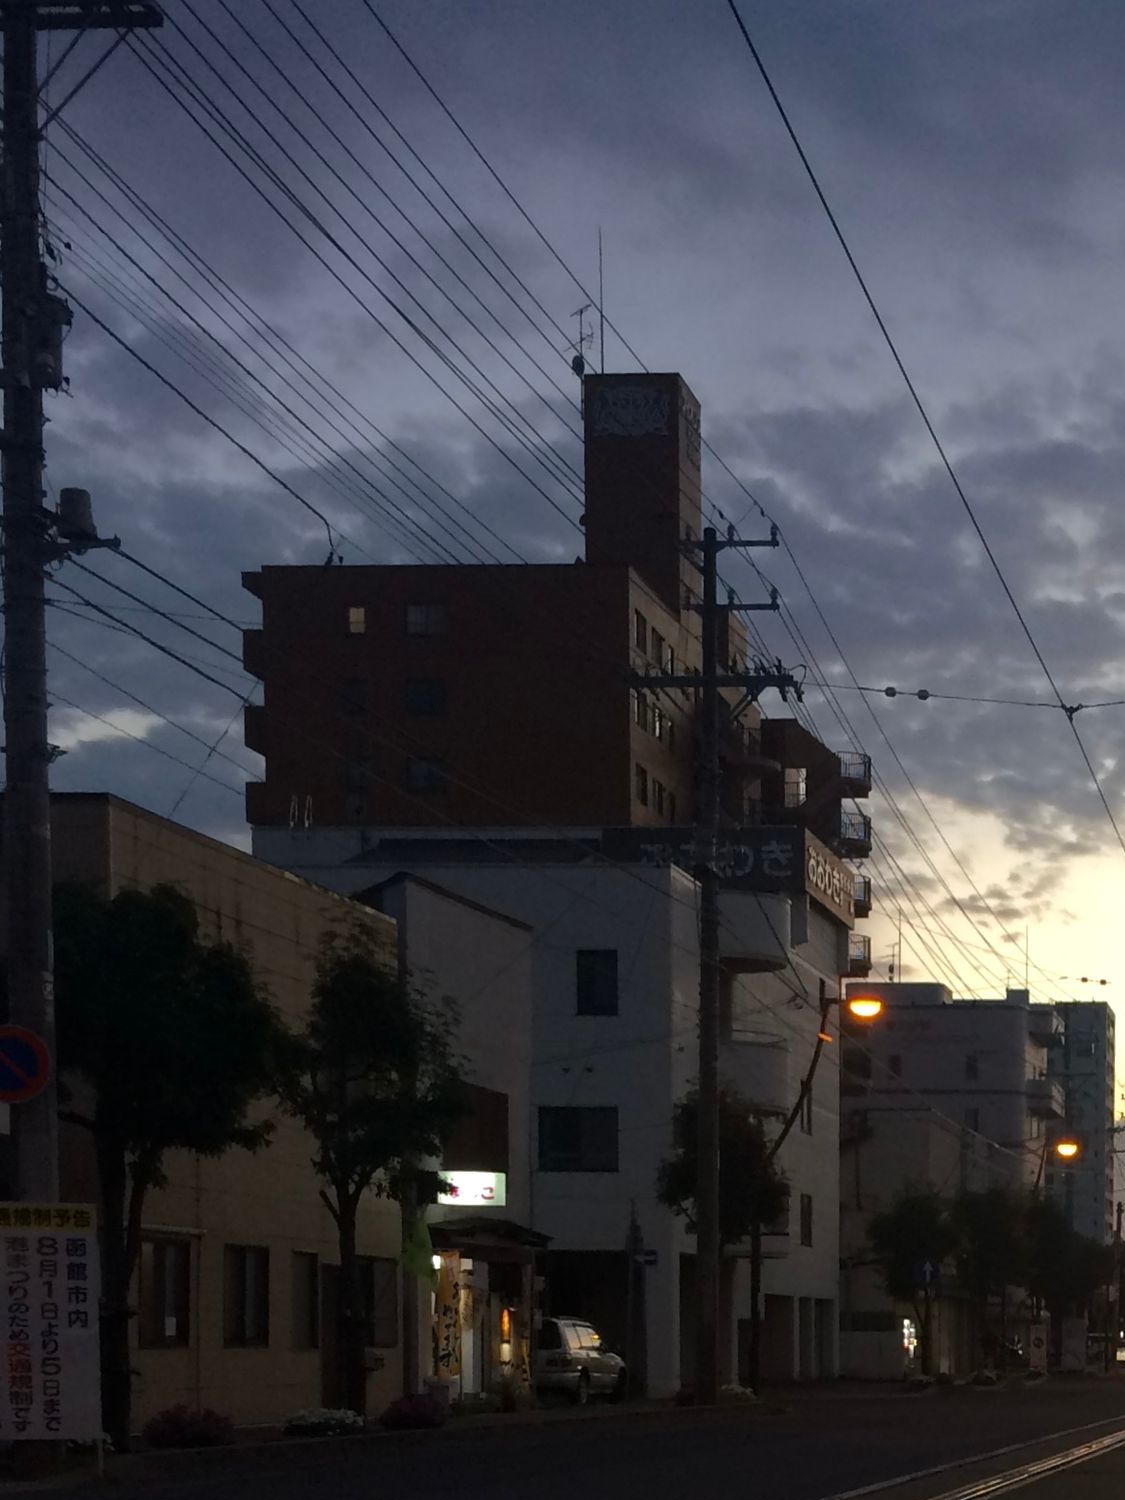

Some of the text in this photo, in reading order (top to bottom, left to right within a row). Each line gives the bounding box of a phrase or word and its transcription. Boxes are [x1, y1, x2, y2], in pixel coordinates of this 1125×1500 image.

[5, 1236, 32, 1432] 港まつりのため交通規制です
[37, 1236, 61, 1432] 8月1日より5日まで
[66, 1238, 88, 1328] 函館市内
